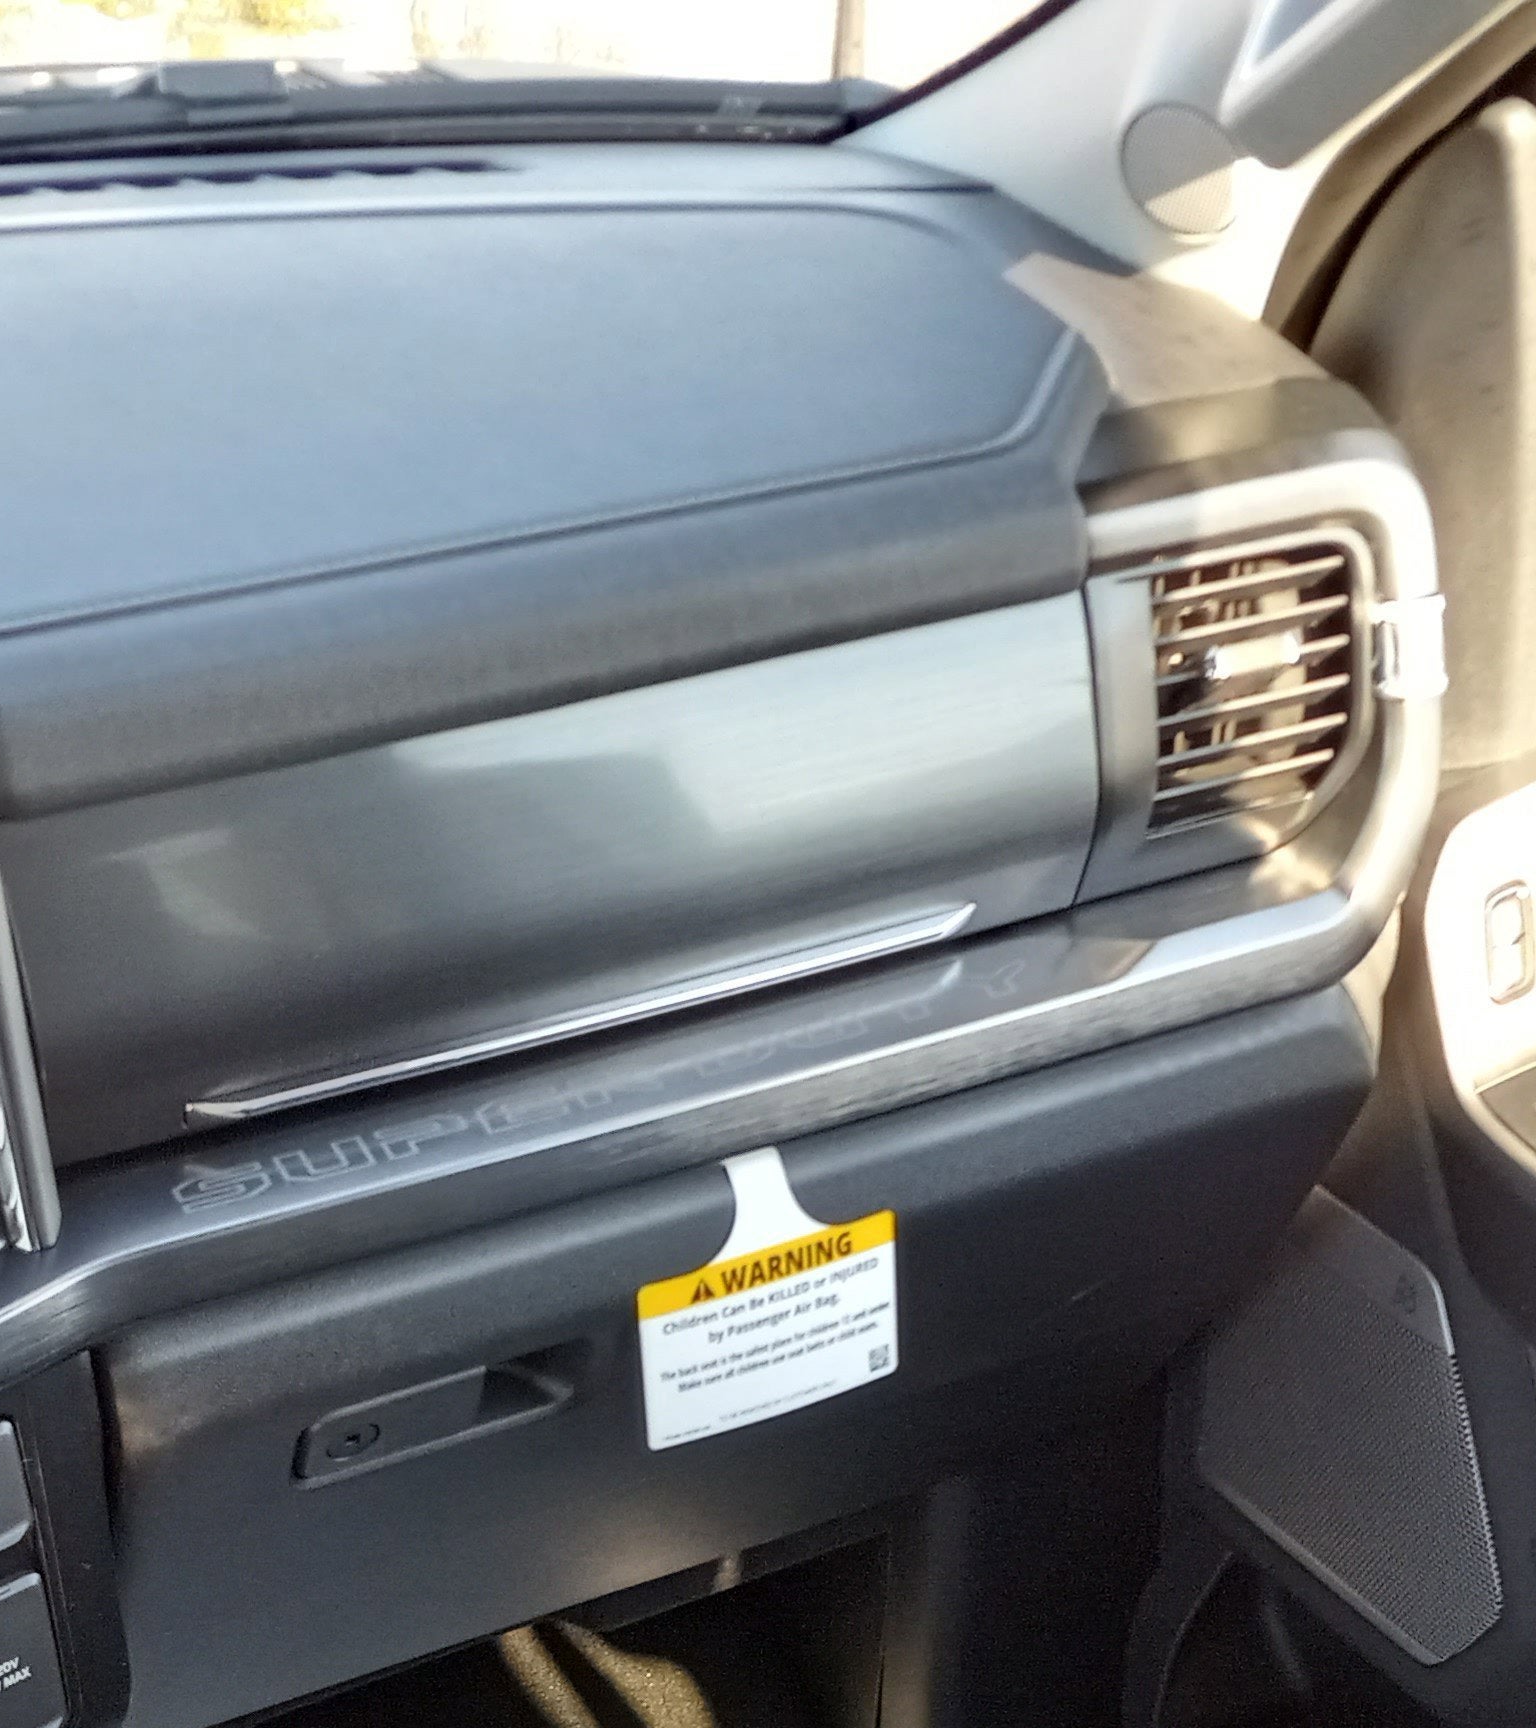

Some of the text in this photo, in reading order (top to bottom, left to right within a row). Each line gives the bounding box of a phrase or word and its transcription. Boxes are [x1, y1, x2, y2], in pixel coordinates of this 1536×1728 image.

[720, 1231, 853, 1295] WARNING
[663, 1257, 879, 1335] Children Can Be KILLED or INJURED
[708, 1330, 724, 1344] by
[727, 1309, 790, 1338] Passenger
[794, 1302, 811, 1316] Air
[3, 1665, 32, 1688] MAX
